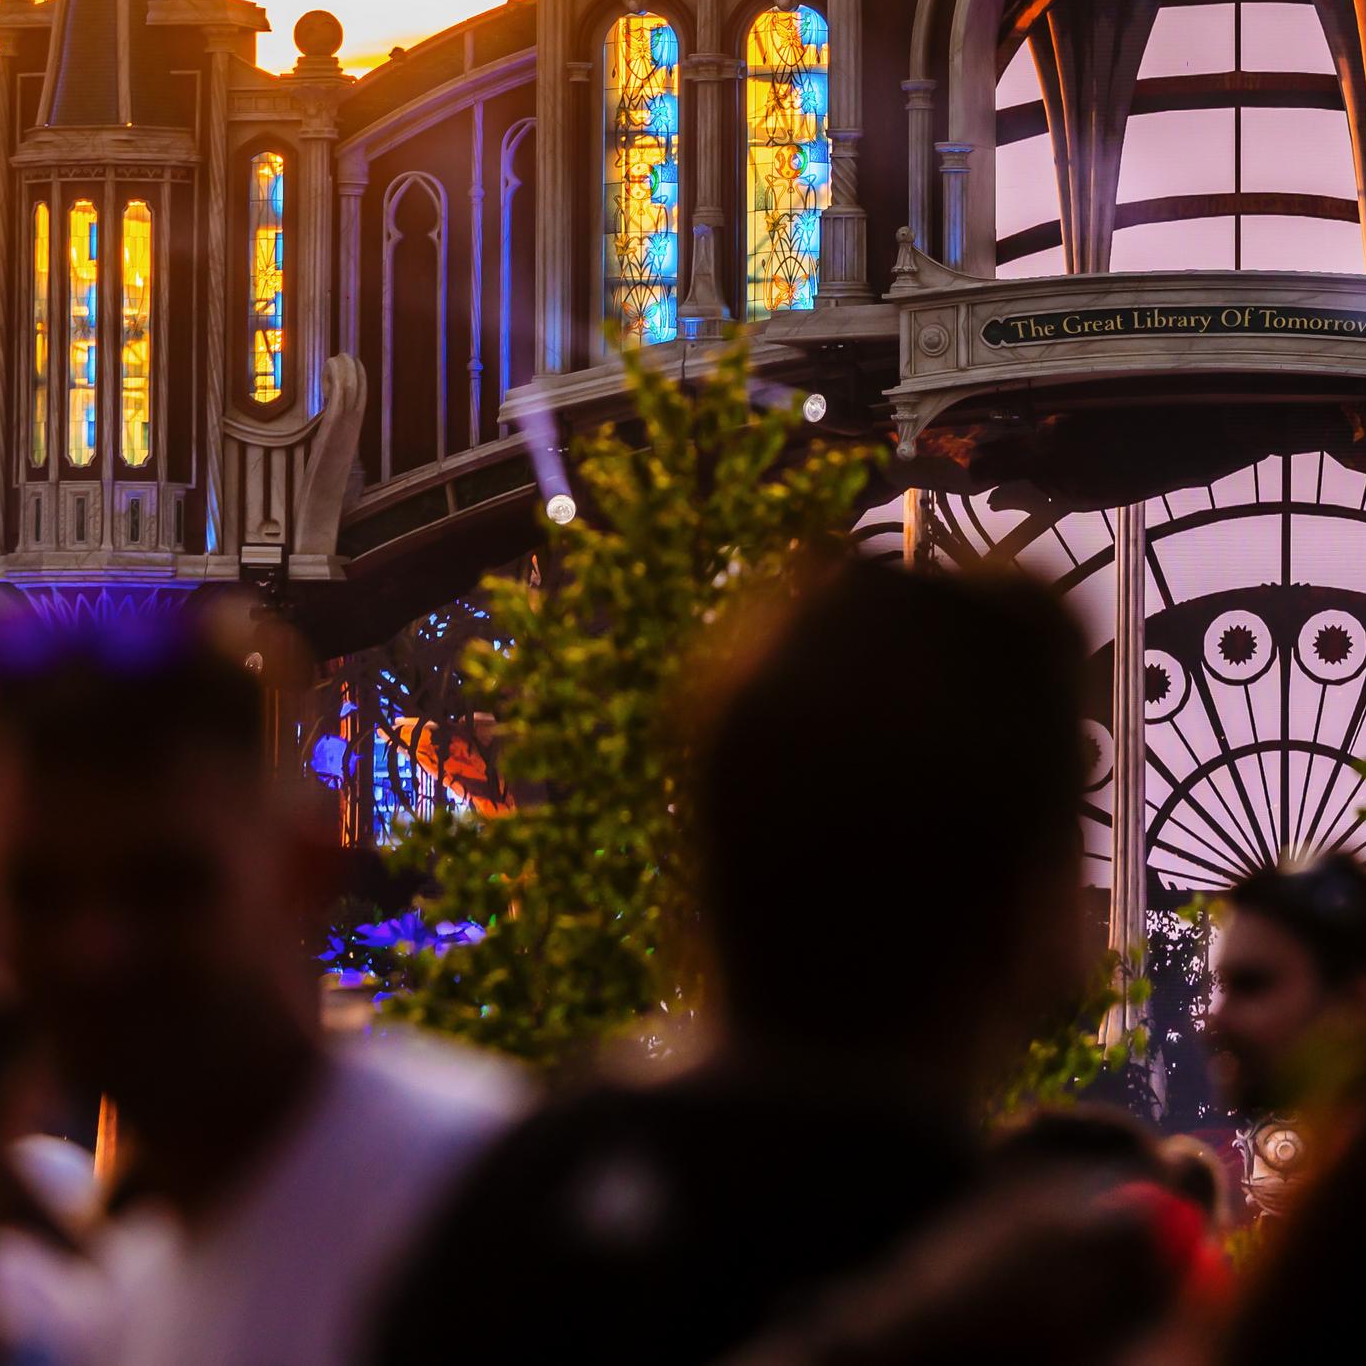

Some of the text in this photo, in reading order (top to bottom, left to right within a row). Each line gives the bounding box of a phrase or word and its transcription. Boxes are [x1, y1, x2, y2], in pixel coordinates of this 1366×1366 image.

[1011, 319, 1055, 339] The
[1063, 314, 1124, 334] Great
[1133, 310, 1212, 333] Library
[1221, 308, 1254, 328] Of
